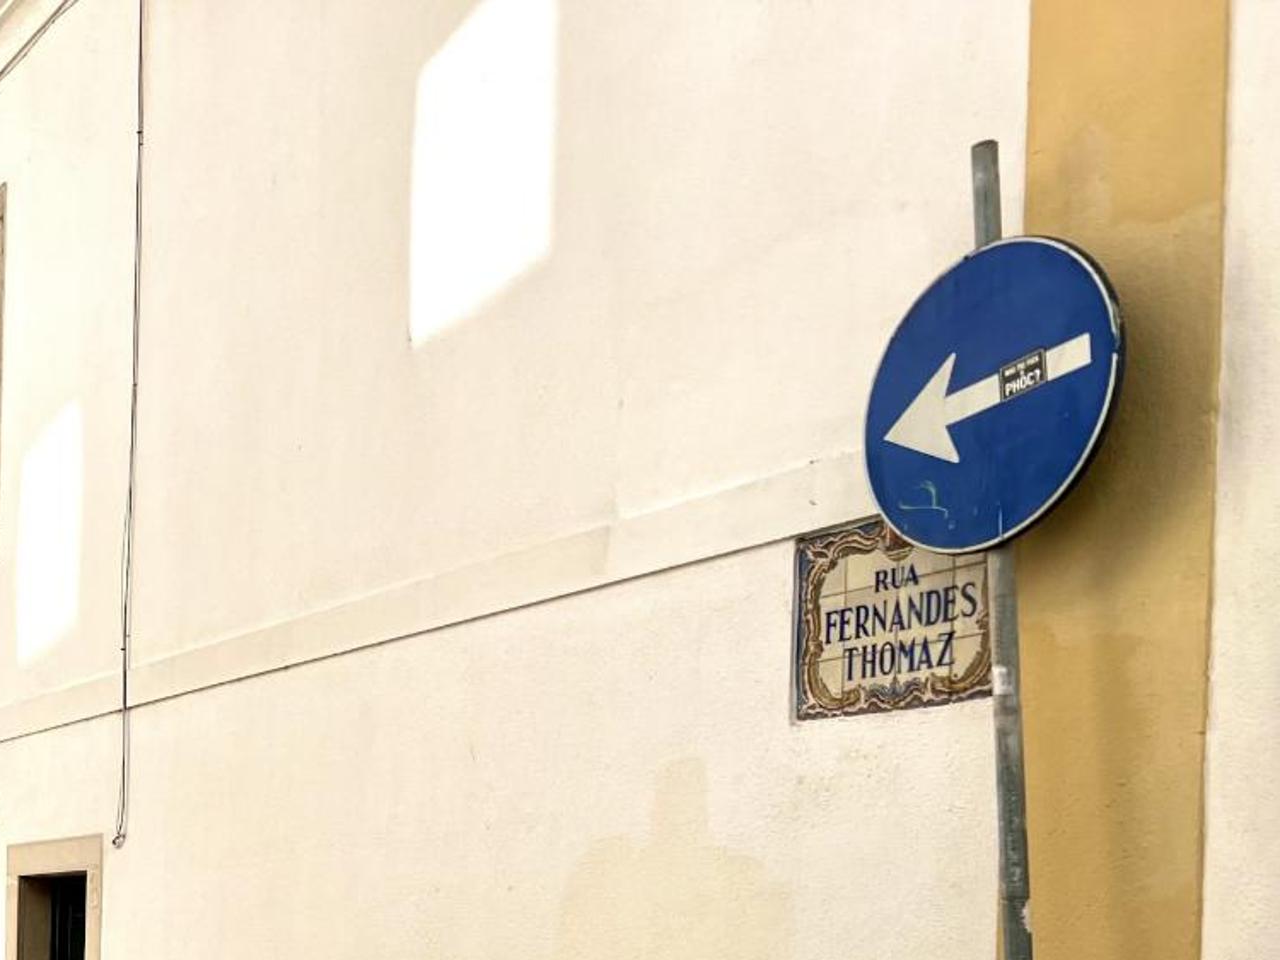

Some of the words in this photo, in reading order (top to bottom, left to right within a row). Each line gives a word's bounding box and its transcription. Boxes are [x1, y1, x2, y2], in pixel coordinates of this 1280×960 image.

[874, 563, 919, 593] RUA
[824, 582, 978, 645] FERNANDES
[843, 630, 956, 682] THOMAZ
